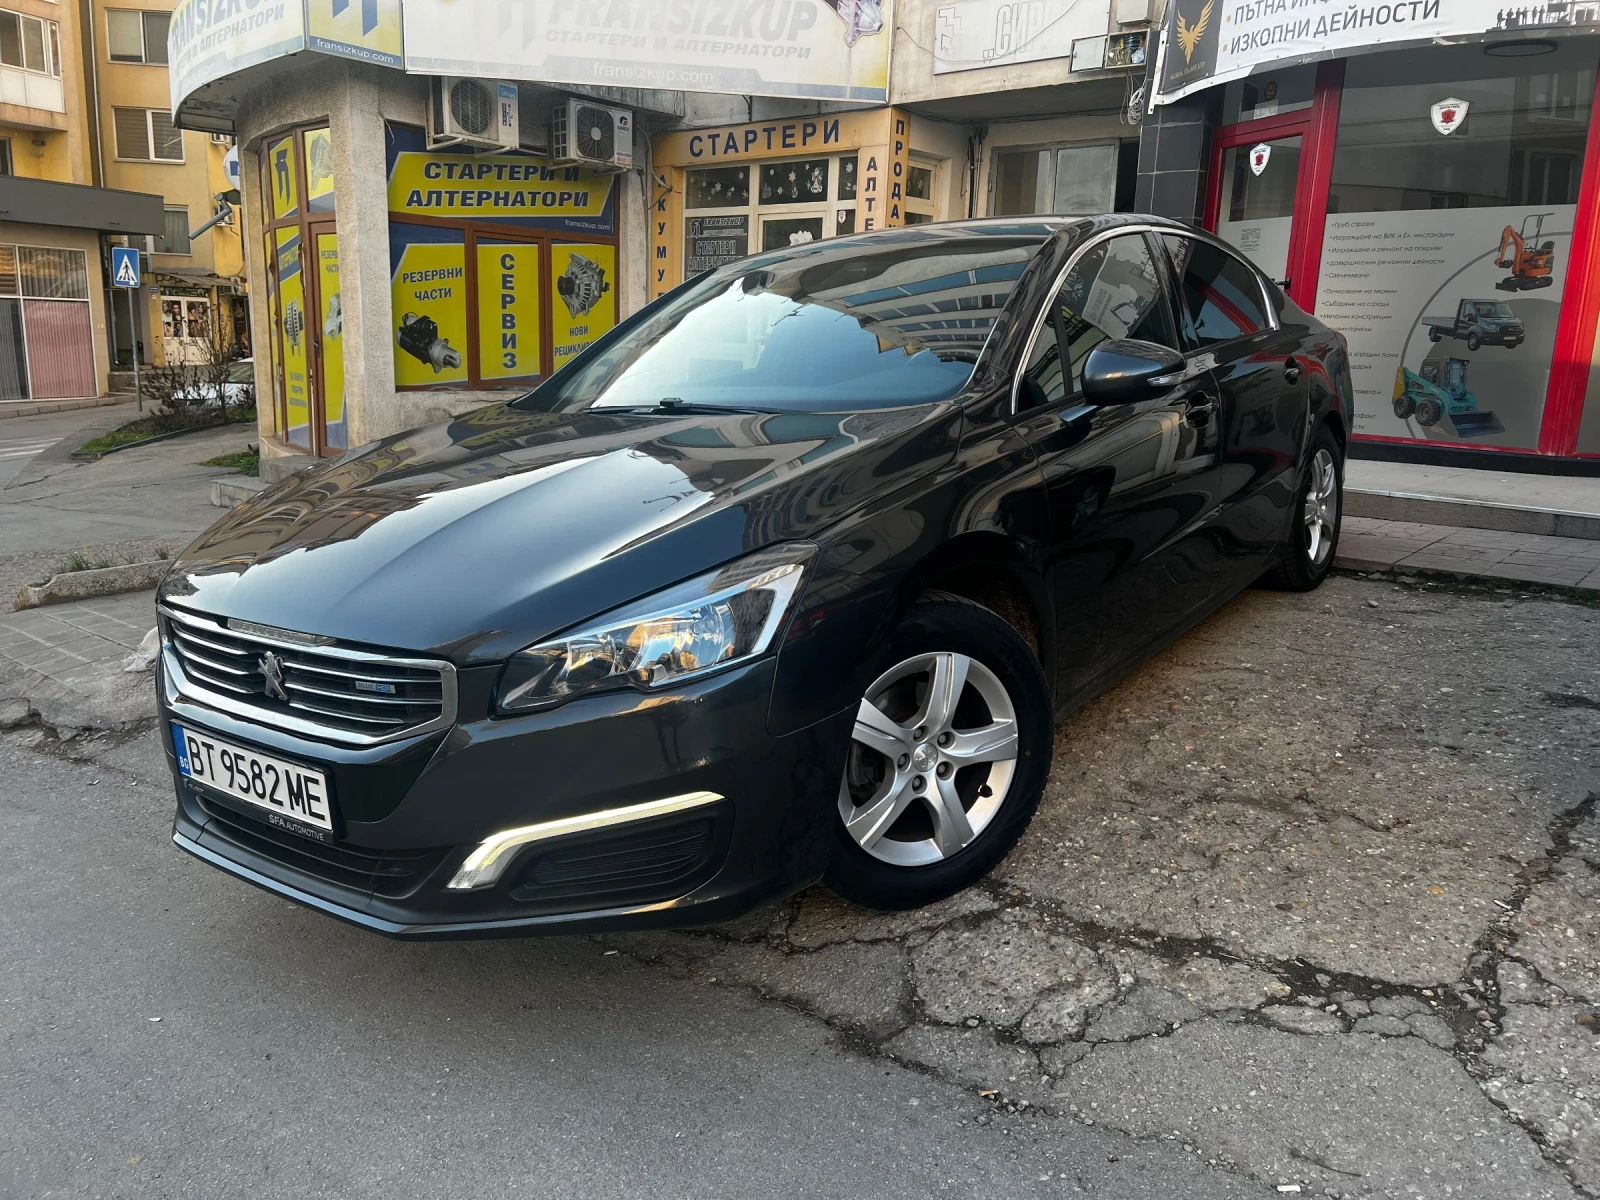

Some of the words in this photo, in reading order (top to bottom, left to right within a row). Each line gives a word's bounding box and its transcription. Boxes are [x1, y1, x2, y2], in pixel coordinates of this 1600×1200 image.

[1235, 0, 1287, 25] ПЪТНА
[1231, 18, 1311, 55] ИЗКОПНИ
[1313, 0, 1440, 39] ДЕЙНОСТИ
[317, 39, 394, 63] fransizkup.com
[546, 29, 646, 48] СТАРТЕРИ
[654, 37, 668, 49] И
[673, 39, 812, 59] АЛТЕРНАТОРИ
[593, 61, 714, 84] fransizkup.com
[689, 119, 840, 158] СТАРТЕРИ
[423, 162, 555, 182] СТАРТЕРИ
[564, 166, 580, 182] И
[889, 119, 905, 228] ПРОДА
[405, 189, 589, 208] АЛТЕРНАТОРИ
[565, 218, 611, 231] fransizkup.com
[402, 267, 463, 284] РЕЗЕРВНИ
[414, 287, 452, 302] ЧАСТИ
[500, 253, 517, 369] СЕРВИЗ
[569, 325, 589, 337] НОВИ
[179, 755, 190, 770] BG
[187, 735, 215, 781] BT
[220, 748, 284, 808] 9582
[284, 768, 326, 822] ME
[269, 814, 286, 827] SFA
[286, 822, 325, 842] AUTOMOTIVE
